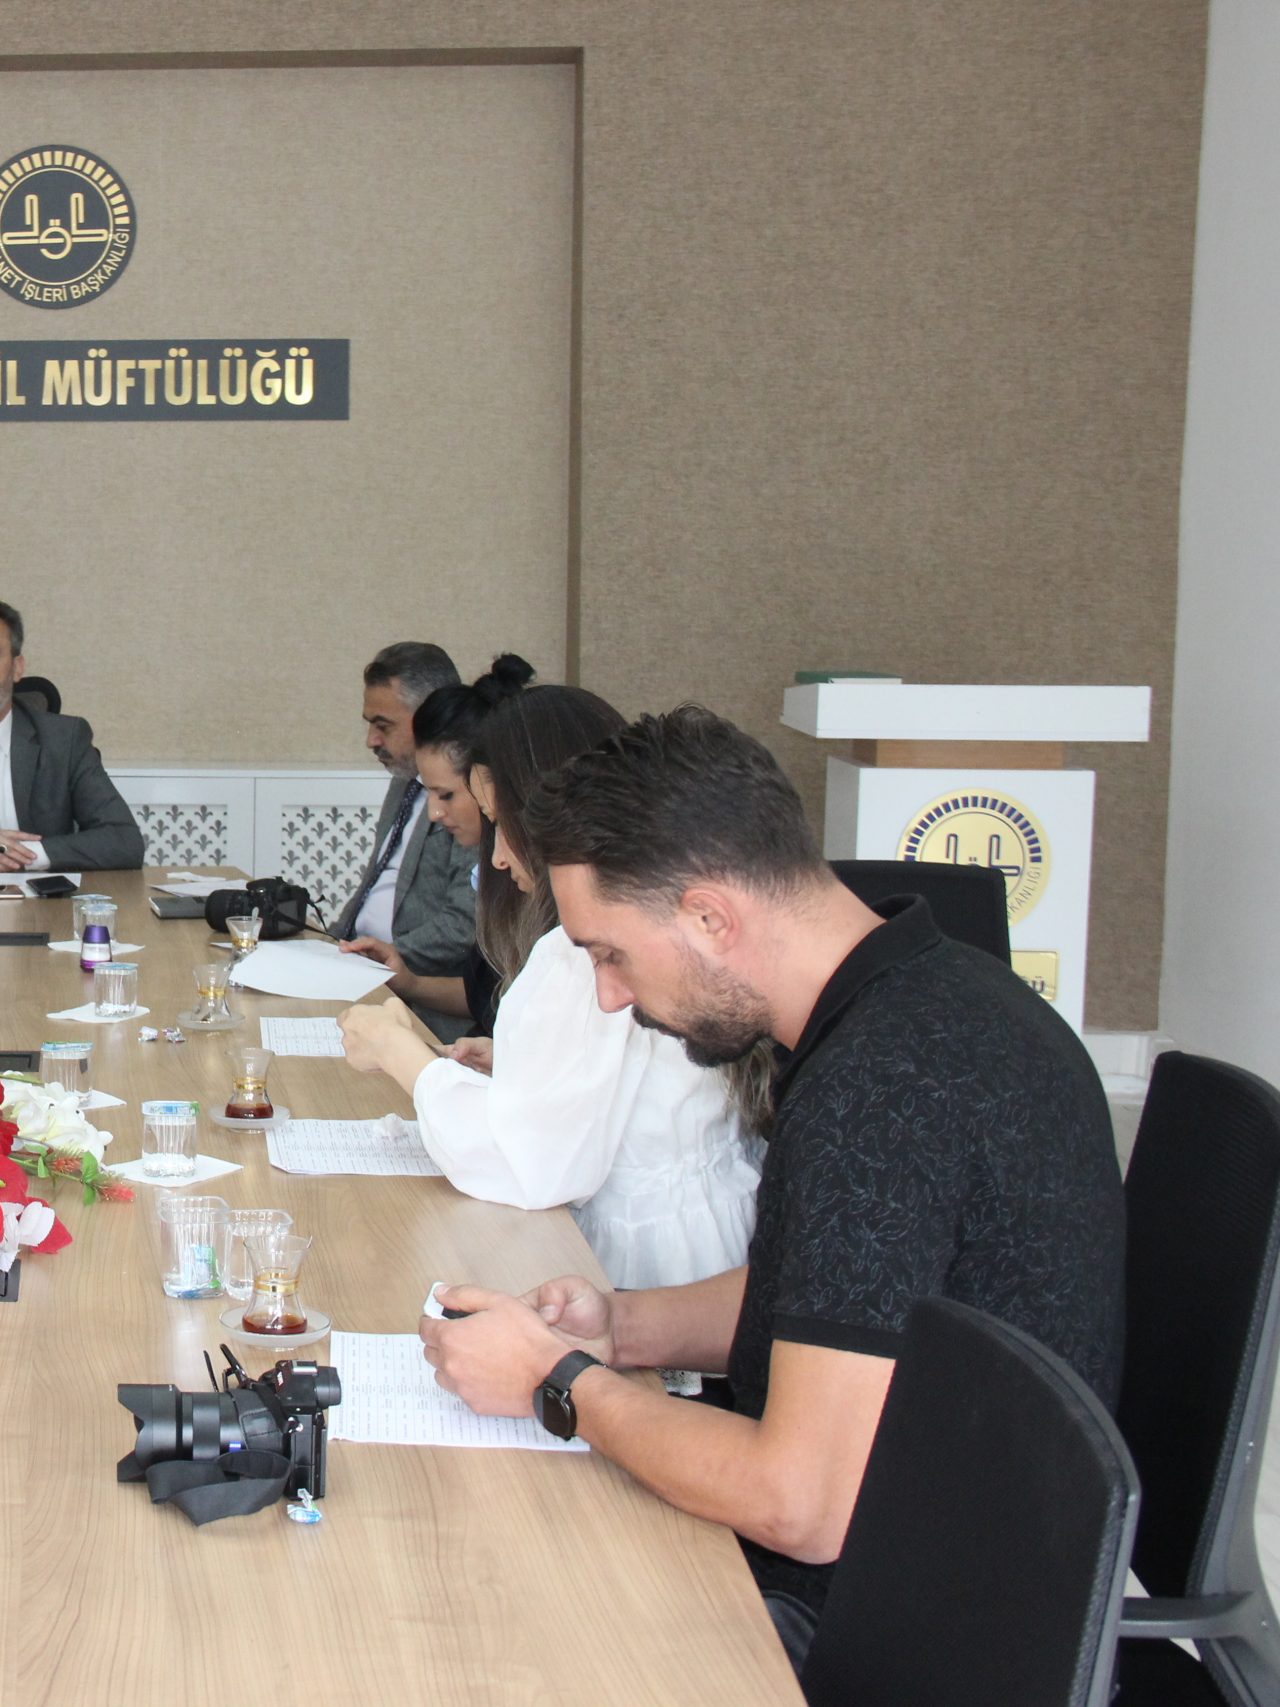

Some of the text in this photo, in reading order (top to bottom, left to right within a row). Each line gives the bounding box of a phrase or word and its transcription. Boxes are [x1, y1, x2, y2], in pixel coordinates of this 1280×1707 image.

[20, 280, 67, 302] İŞLERİ
[70, 228, 131, 299] BAŞKANLIĞI
[42, 347, 314, 406] MÜFTÜLÜĞÜ
[1006, 866, 1042, 913] KANLIĞI
